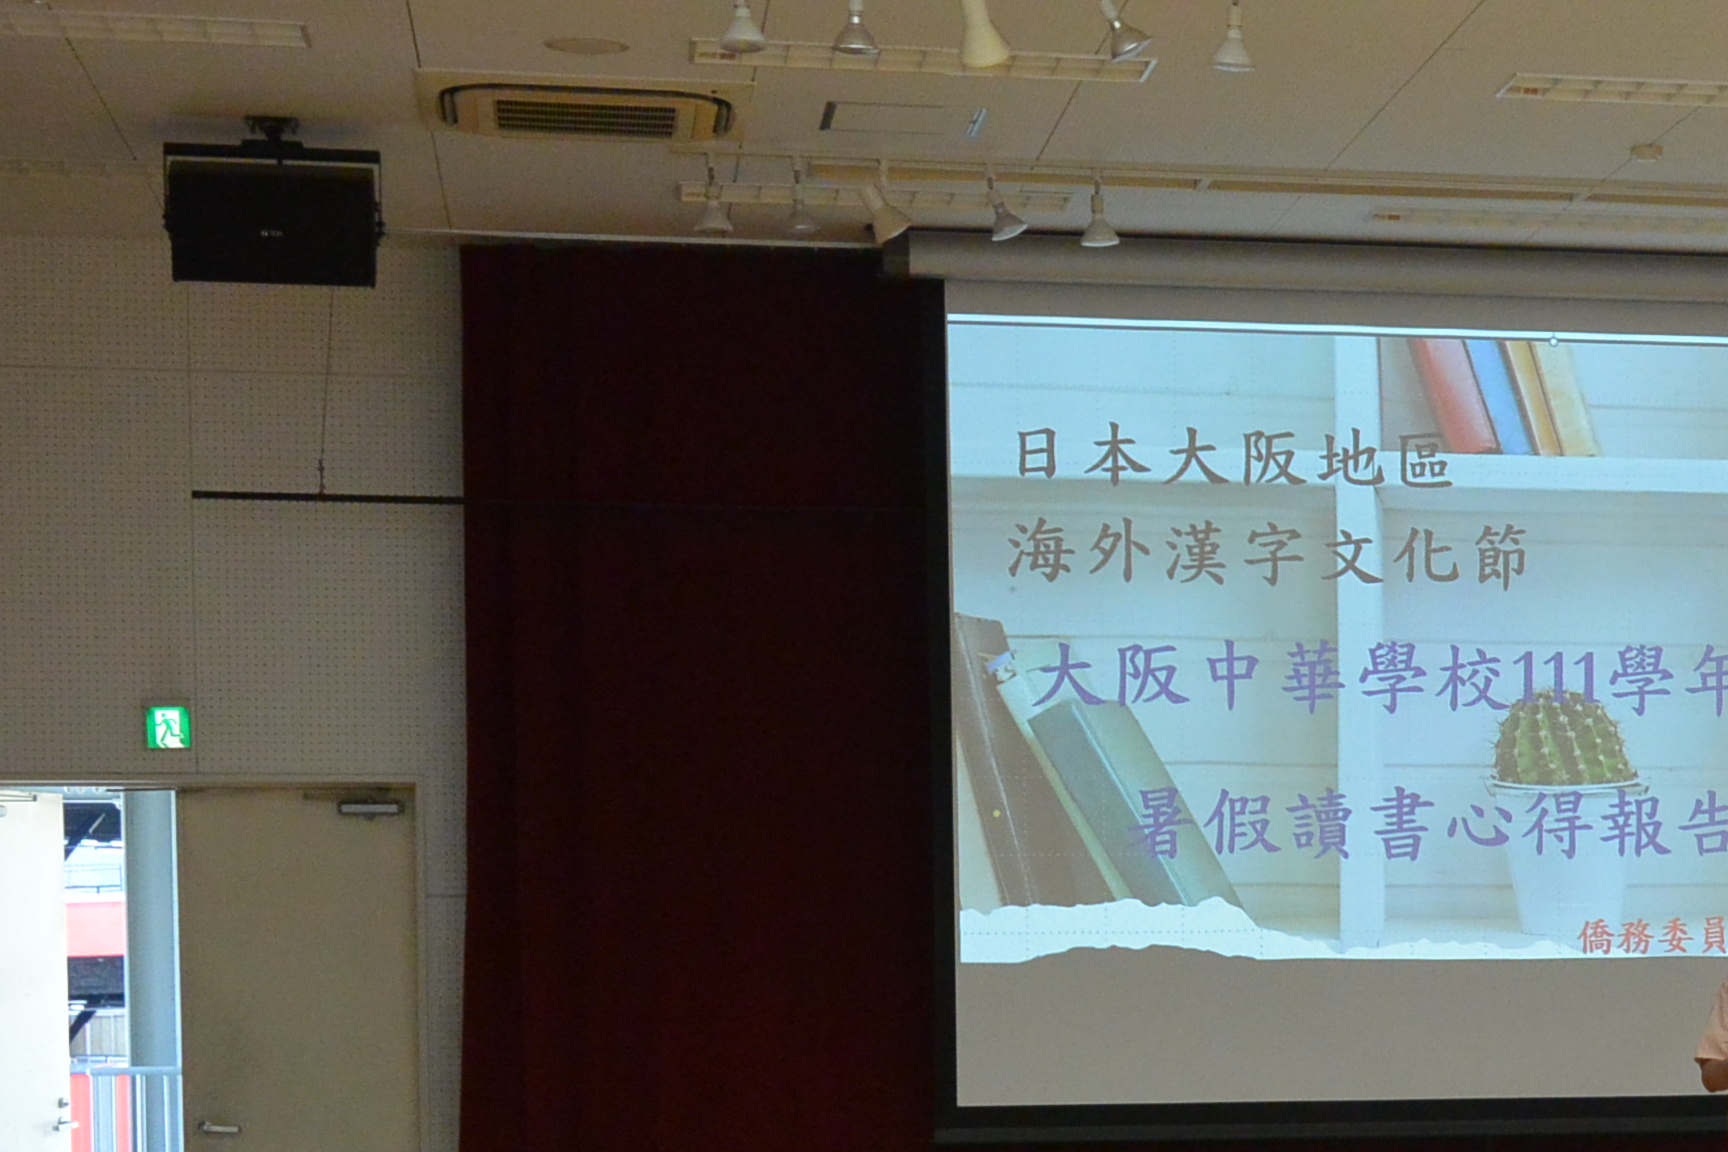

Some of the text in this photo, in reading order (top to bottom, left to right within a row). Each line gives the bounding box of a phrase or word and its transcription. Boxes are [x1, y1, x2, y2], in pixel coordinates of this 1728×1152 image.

[1016, 422, 1453, 489] 日本大阪地區
[1008, 517, 1527, 592] 海外漢字文化節
